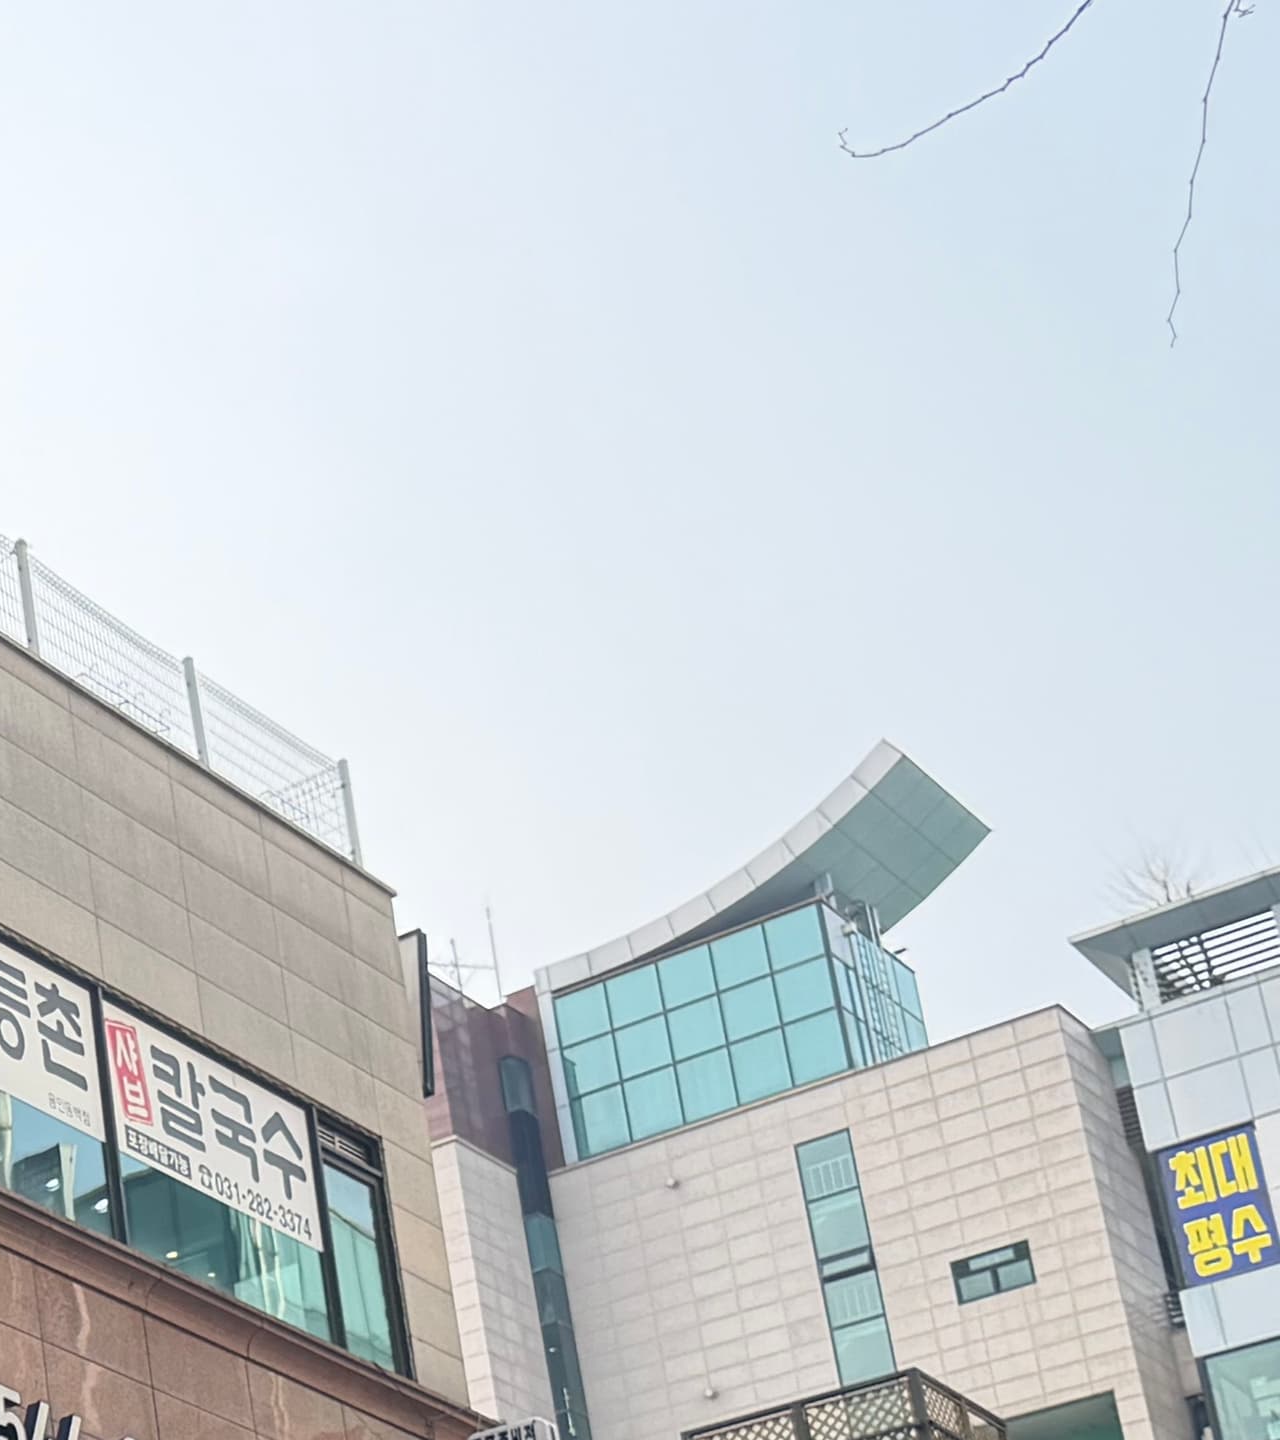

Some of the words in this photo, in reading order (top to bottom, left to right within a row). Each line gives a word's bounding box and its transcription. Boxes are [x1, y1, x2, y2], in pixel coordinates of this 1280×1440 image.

[126, 1127, 190, 1180] 포장배달가능
[151, 1042, 307, 1201] 칼국수
[1167, 1130, 1260, 1210] 최대
[1186, 1206, 1272, 1278] 평수
